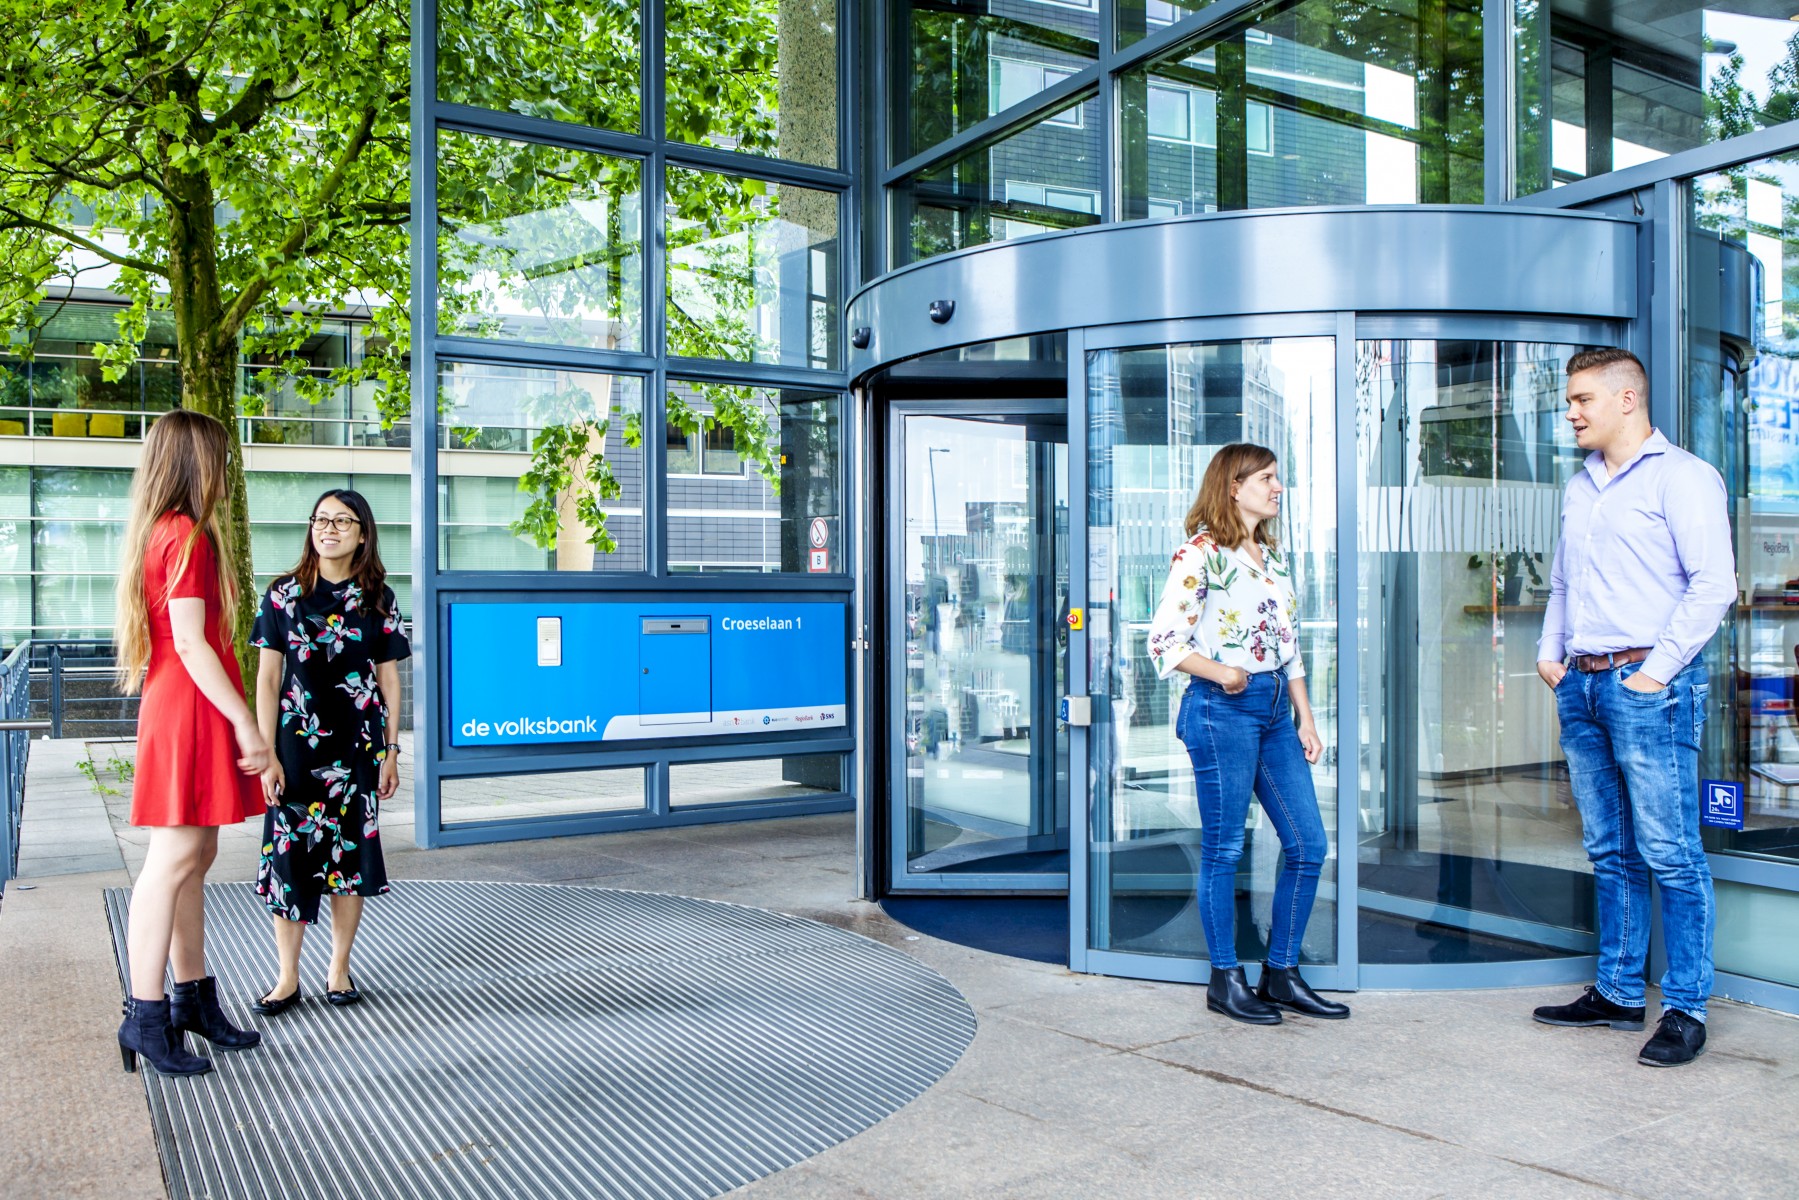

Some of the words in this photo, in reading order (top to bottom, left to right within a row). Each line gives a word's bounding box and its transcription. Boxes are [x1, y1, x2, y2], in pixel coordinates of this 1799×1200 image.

[721, 616, 793, 631] Croeselaan
[795, 616, 801, 630] 1
[825, 712, 835, 720] SNS
[461, 718, 490, 737] de
[493, 715, 597, 736] volksbank
